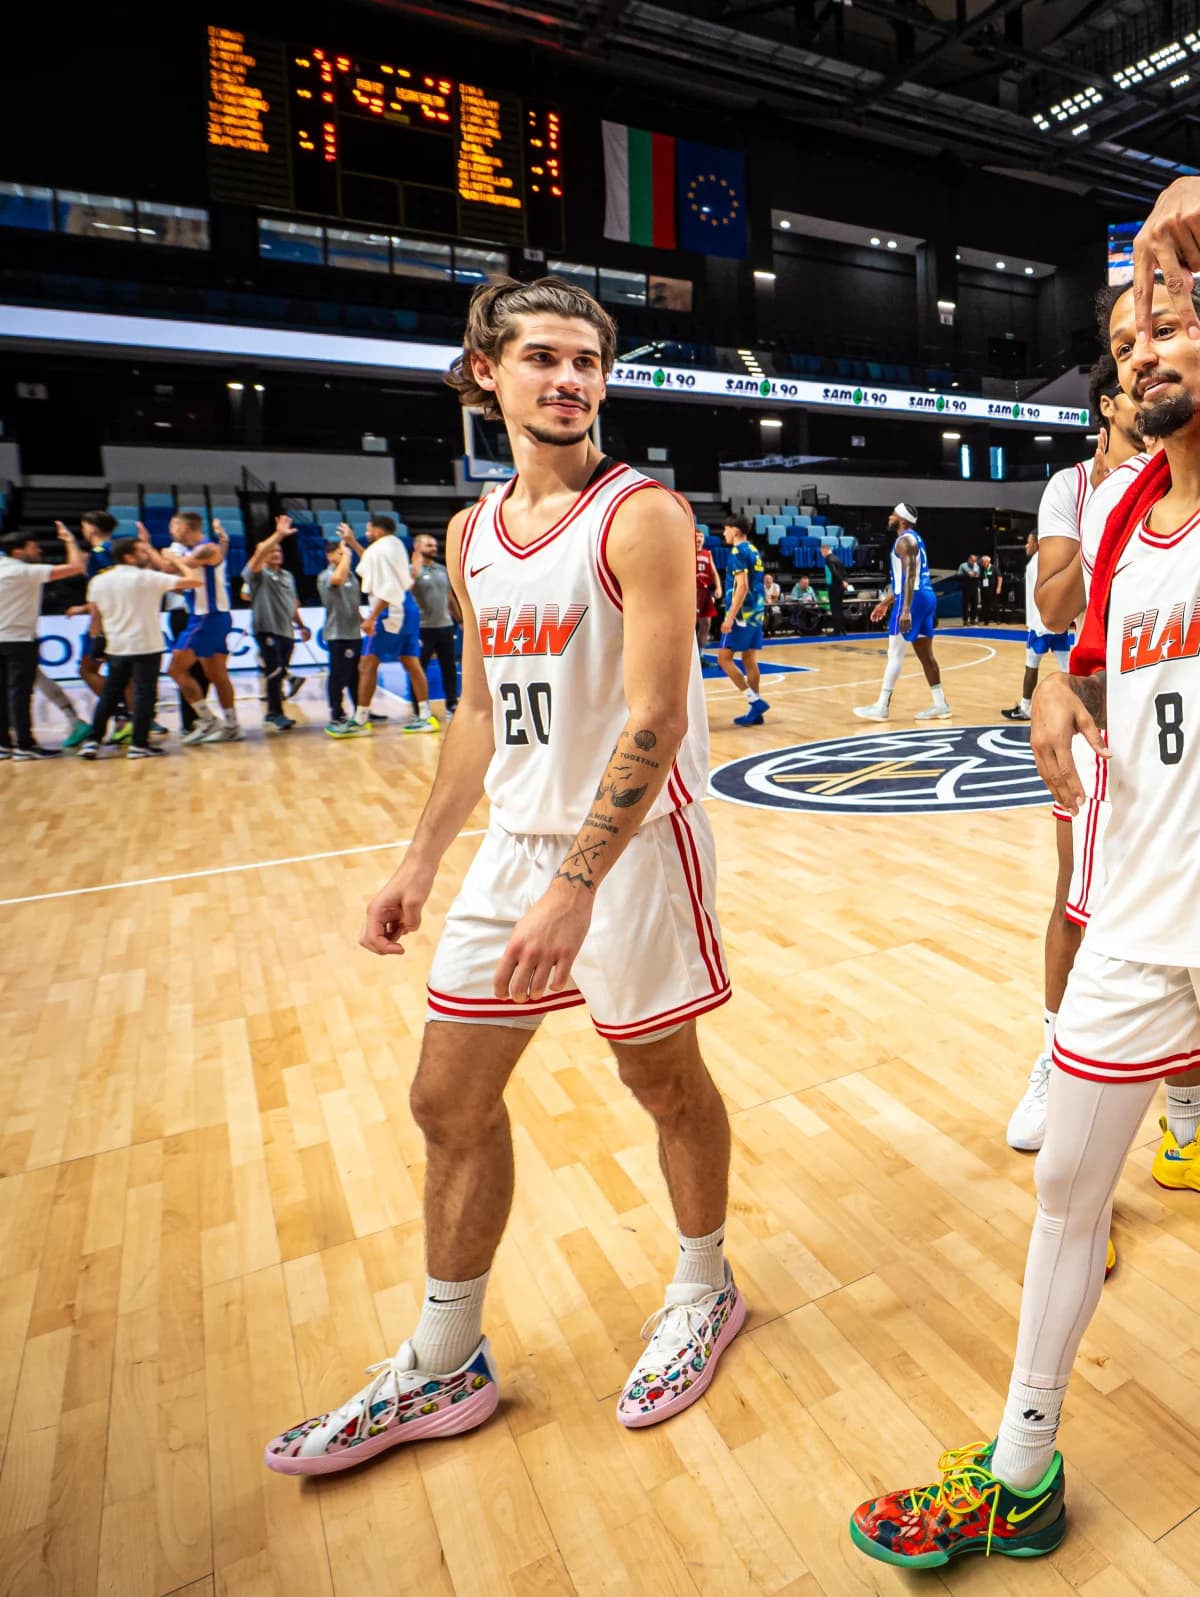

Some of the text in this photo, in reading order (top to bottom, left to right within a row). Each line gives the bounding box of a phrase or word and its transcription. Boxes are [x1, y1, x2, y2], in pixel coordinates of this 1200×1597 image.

[676, 374, 696, 386] 90
[780, 384, 798, 396] 90
[871, 393, 887, 404] 90
[952, 400, 967, 411] 90
[1027, 408, 1040, 418] 90
[479, 603, 589, 658] ELAN
[499, 682, 551, 745] 20
[1154, 691, 1185, 766] 8
